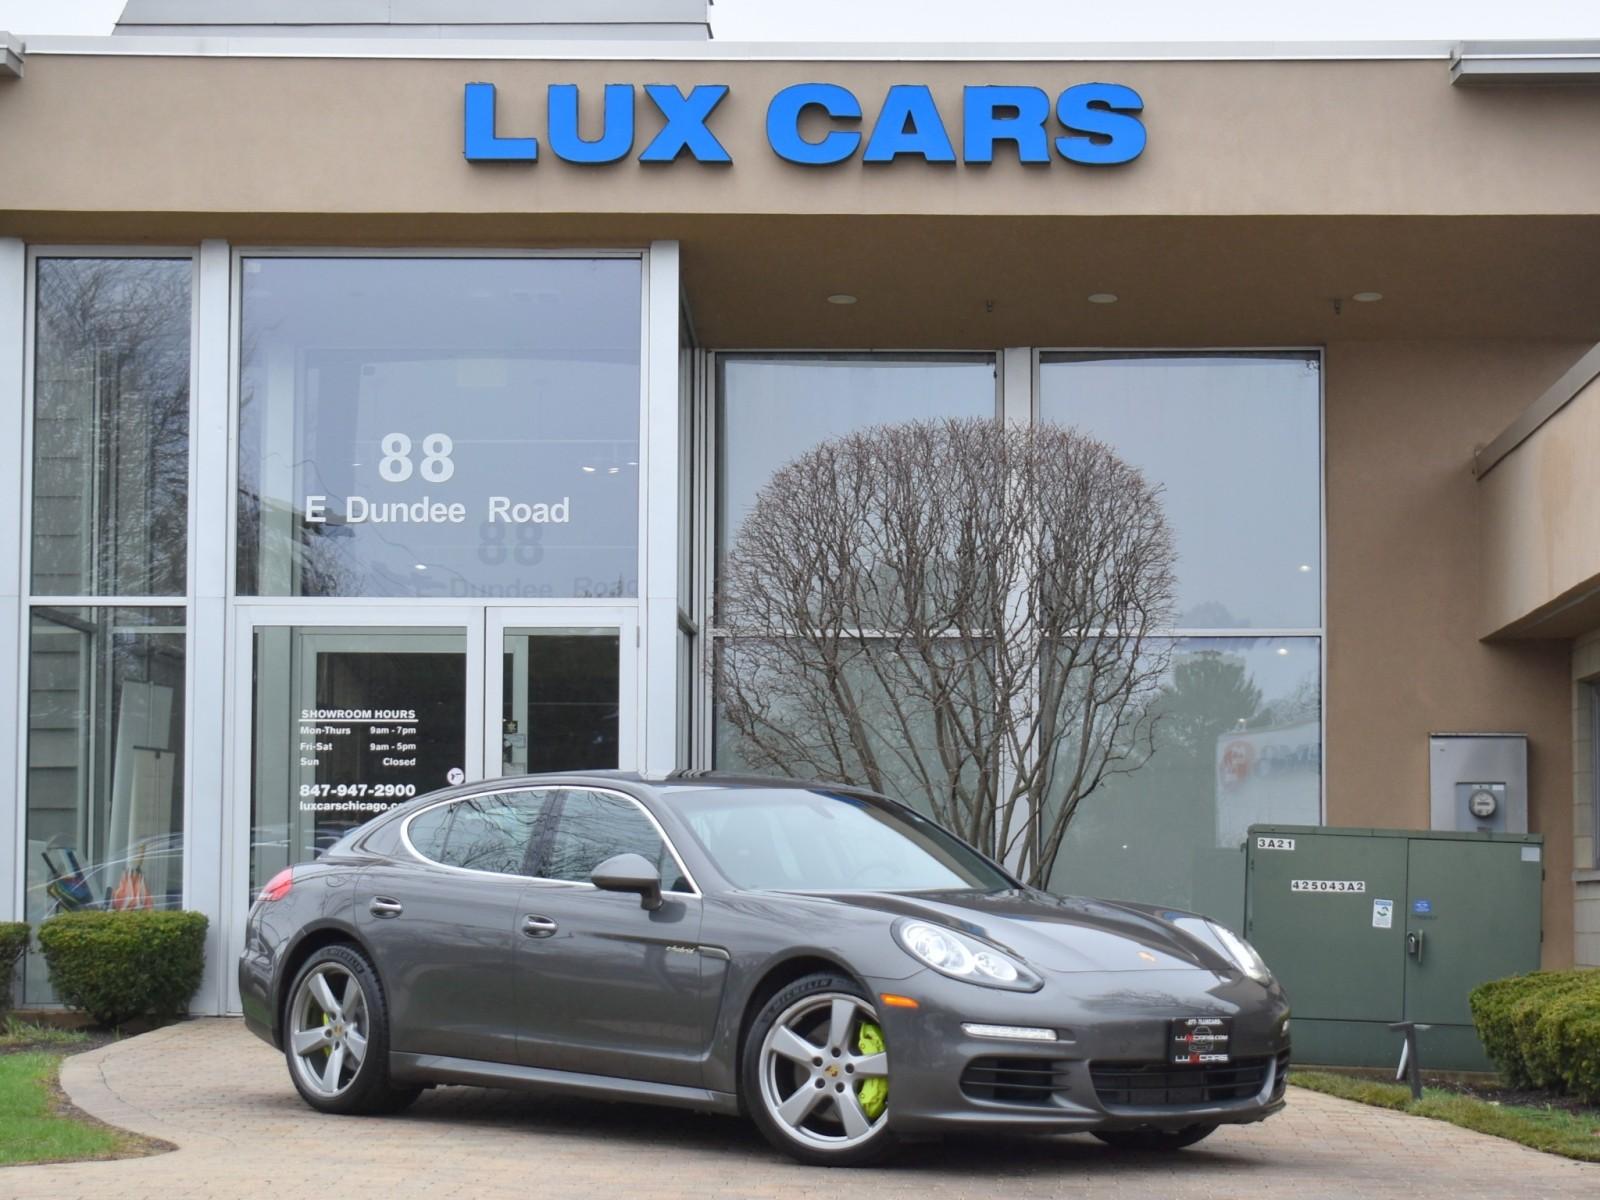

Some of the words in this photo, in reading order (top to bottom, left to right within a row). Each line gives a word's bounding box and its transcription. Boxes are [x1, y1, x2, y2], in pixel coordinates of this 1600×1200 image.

[463, 81, 733, 165] LUX
[765, 81, 1148, 167] CARS
[378, 432, 455, 483] 88
[305, 495, 327, 523] E
[345, 496, 466, 523] Dundee
[488, 496, 570, 523] Road
[301, 709, 372, 719] SHOWROOM
[374, 709, 416, 719] HOURS
[300, 727, 351, 735] Mon-Thurs
[370, 726, 389, 735] 9am
[397, 727, 416, 736] 7pm
[300, 742, 333, 751] Fri-Sat
[370, 743, 389, 751] 9am
[397, 743, 416, 752] 5pm
[300, 757, 320, 767] Sun
[382, 757, 416, 767] Closed
[299, 784, 416, 797] 847-947-2900
[300, 801, 403, 812] luxcarschicago.c
[1258, 839, 1294, 850] 3A21
[1291, 881, 1364, 891] 425043A2
